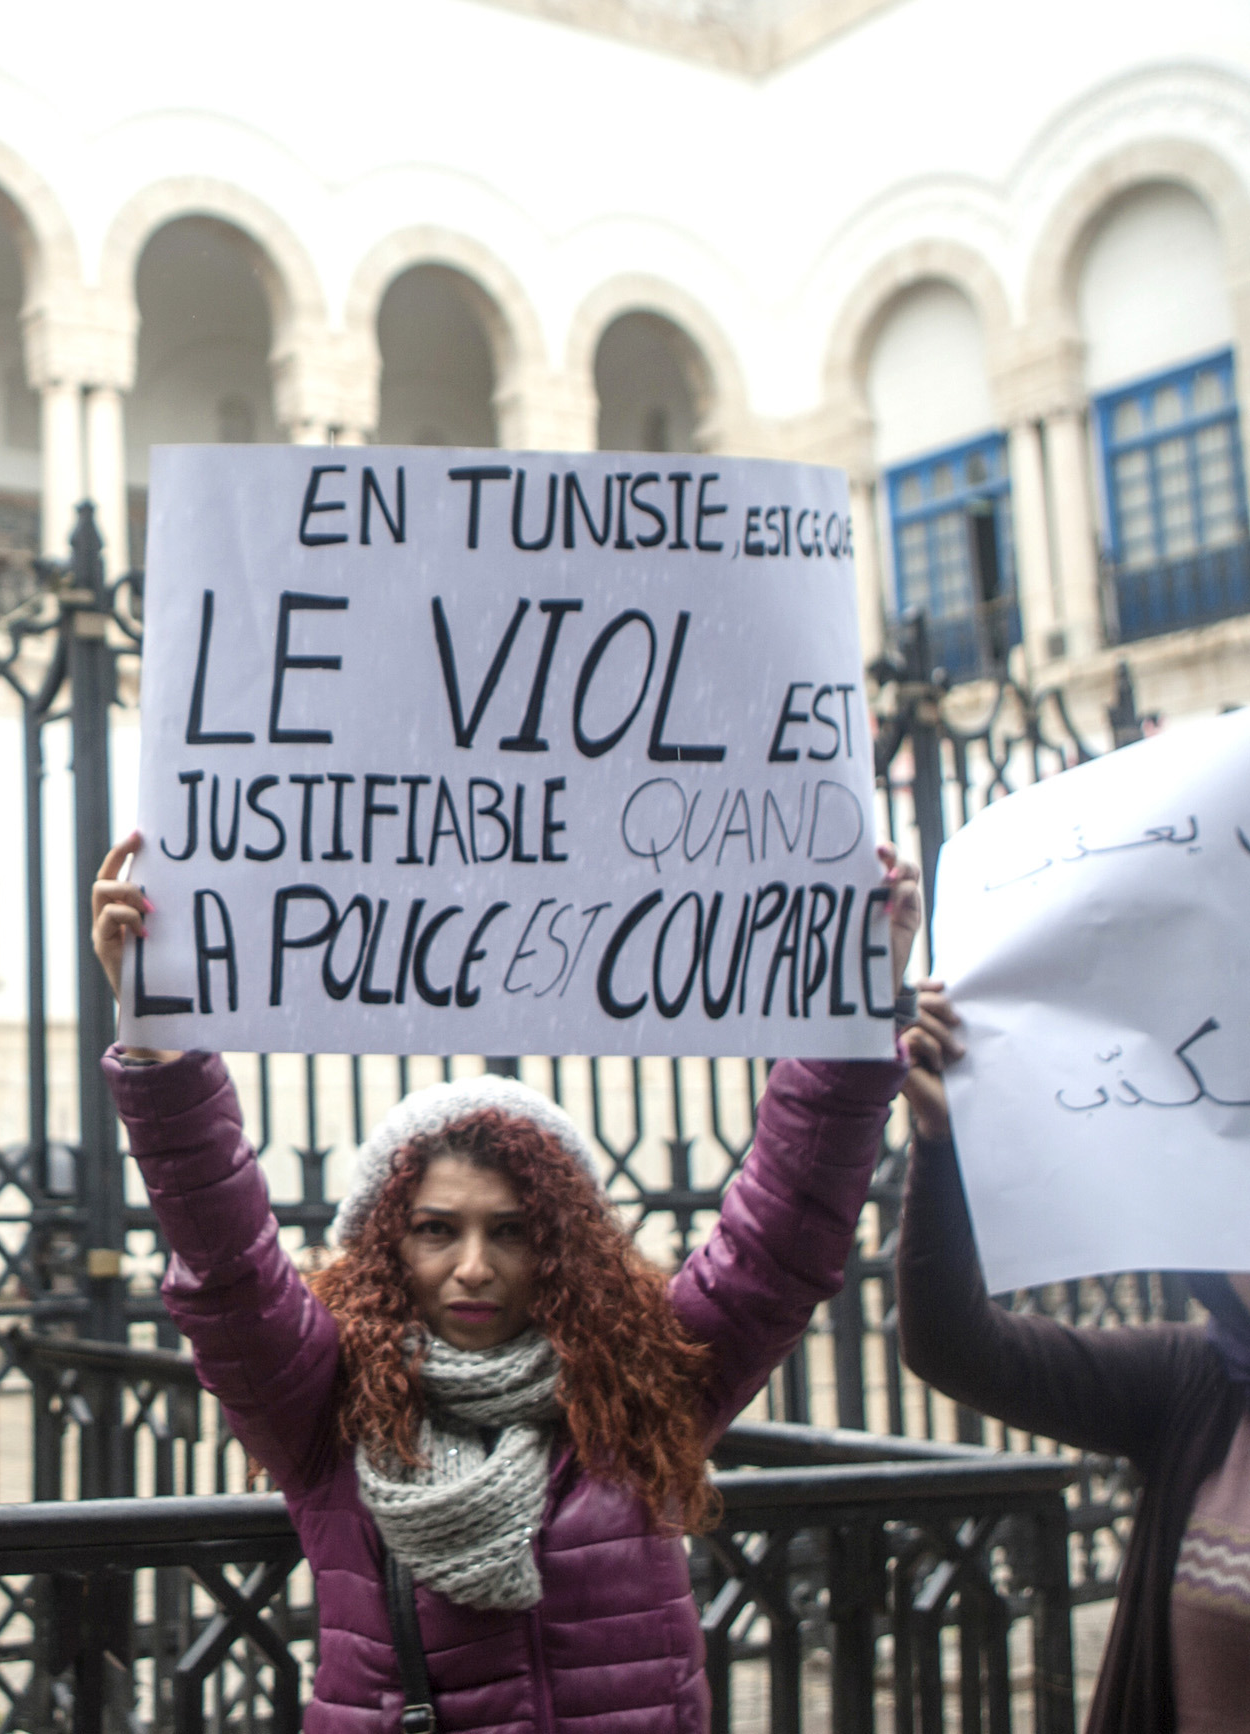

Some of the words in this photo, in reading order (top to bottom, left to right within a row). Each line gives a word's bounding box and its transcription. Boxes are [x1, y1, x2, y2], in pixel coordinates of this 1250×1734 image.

[298, 464, 406, 548] EN
[743, 505, 791, 557] EST
[185, 589, 350, 745] LE
[431, 595, 727, 764] VIOL
[767, 682, 857, 764] EST
[160, 770, 569, 867] JUSTIFIABLE
[621, 776, 864, 875] QUAND
[134, 885, 239, 1019] LA
[268, 883, 511, 1009] POLICE
[503, 897, 613, 998] EST
[596, 880, 896, 1020] COUPABLE
